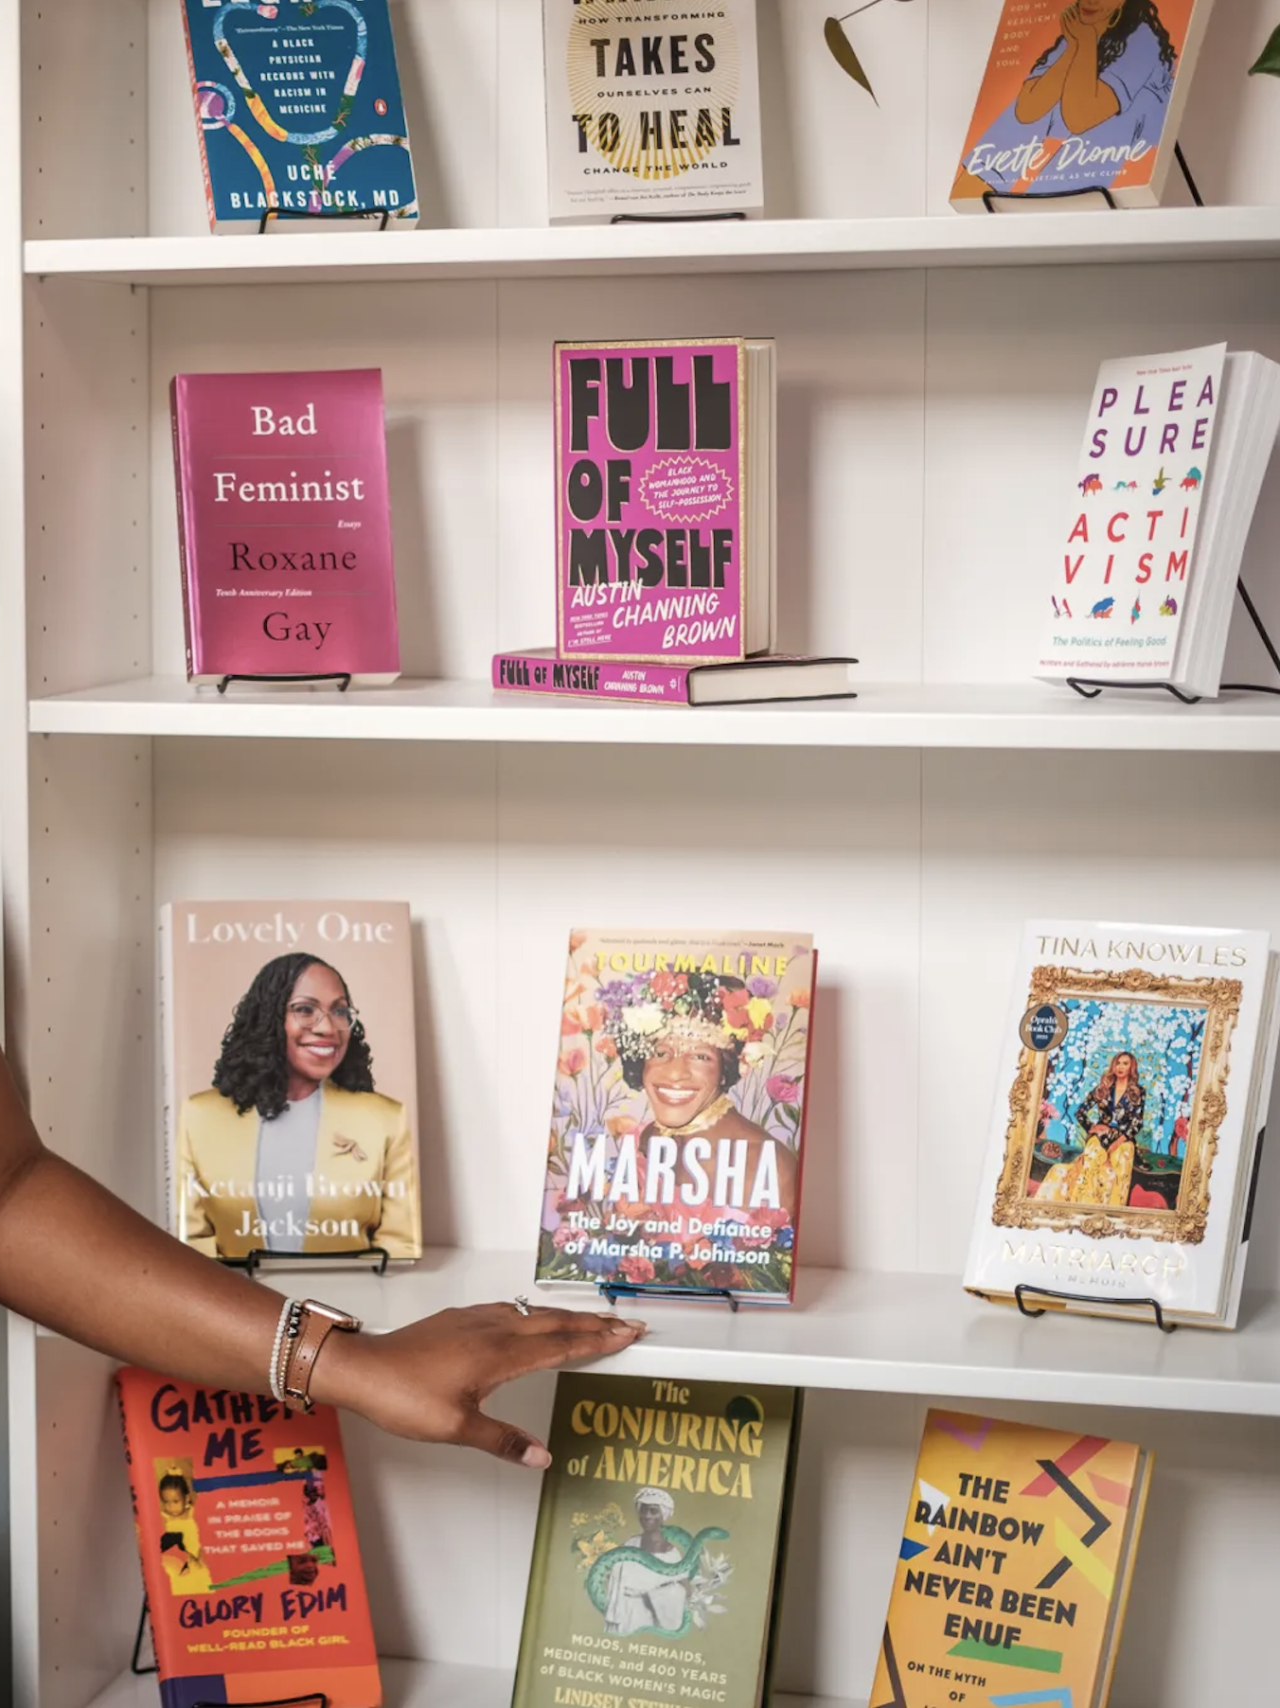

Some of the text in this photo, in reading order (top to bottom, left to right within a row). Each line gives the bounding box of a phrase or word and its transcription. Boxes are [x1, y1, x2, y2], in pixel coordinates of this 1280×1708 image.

[616, 11, 725, 22] TRANSFORMING
[272, 39, 314, 48] A BLACK
[590, 33, 716, 77] TAKES
[269, 55, 322, 64] PHYSICIAN
[260, 71, 335, 81] RECKONS WITH
[274, 88, 326, 97] RACISM IN
[597, 88, 678, 98] OURSELVES
[279, 104, 327, 114] MEDICINE
[572, 107, 740, 153] TO HEAL
[287, 160, 336, 181] UCHÉ
[583, 166, 639, 175] CHANGE
[679, 161, 728, 170] WORLD
[967, 135, 1152, 181] Evette Dionne
[1100, 169, 1128, 177] CLIMB
[230, 190, 399, 209] BLACKSTOCK, MD
[568, 355, 732, 453] FULL
[1097, 374, 1214, 418] PLEA
[251, 403, 318, 436] Bad
[1088, 418, 1209, 458] SURE
[213, 470, 365, 502] Feminist
[648, 474, 716, 489] WOMANHOOD AND
[668, 466, 693, 477] BLACK
[566, 458, 631, 523] OF
[653, 484, 718, 499] THE JOURNEY TO
[658, 494, 722, 510] SELF-POSSESSION
[337, 519, 362, 530] Essays
[1067, 507, 1189, 543] ACTI
[228, 542, 357, 571] Roxane
[568, 528, 733, 590] MYSELF
[1063, 550, 1189, 584] VISM
[215, 588, 312, 599] Tenth Anniversary Edition
[571, 578, 643, 609] AUSTIN
[612, 592, 720, 628] CHANNING
[262, 611, 333, 650] Gay
[662, 614, 737, 649] BROWN
[1053, 636, 1167, 648] The Politics of Feeling Good
[500, 659, 600, 691] FULL OF MYSELF
[603, 682, 665, 694] CHANNING BROWN
[622, 670, 647, 681] AUSTIN
[187, 912, 394, 948] Lovely One
[595, 952, 788, 976] TOURMALINE
[1036, 935, 1247, 966] TINA KNOWLES
[566, 1133, 781, 1209] MARSHA
[186, 1173, 406, 1203] Ketanji Brown
[234, 1210, 360, 1237] Jackson
[568, 1212, 771, 1238] The Joy and Defiance
[565, 1239, 770, 1264] of Marsha P. Johnson
[1002, 1240, 1182, 1279] MATRIARCH
[1068, 1275, 1127, 1288] MEMOIR
[651, 1379, 690, 1404] The
[151, 1383, 316, 1432] GATHE
[571, 1400, 764, 1458] CONJURING
[204, 1428, 265, 1469] ME
[567, 1446, 753, 1498] of AMERICA
[958, 1472, 1010, 1504] THE
[207, 1511, 291, 1524] IN PRAISE OF
[216, 1497, 279, 1509] A MEMOIR
[214, 1527, 289, 1538] THE BOOKS
[914, 1500, 1045, 1547] RAINBOW
[204, 1541, 304, 1554] THAT SAVED ME
[933, 1540, 1007, 1575] AIN'T
[179, 1583, 347, 1629] GLORY EDIM
[904, 1568, 1077, 1627] NEVER BEEN
[187, 1635, 350, 1653] WELL-READ BLACK GIRL
[222, 1625, 310, 1638] FOUNDER OF
[943, 1613, 1022, 1650] ENUF
[571, 1634, 706, 1666] MOJOS, MERMAIDS,
[543, 1647, 727, 1685] MEDICINE, and 400 YEARS
[907, 1661, 987, 1688] ON THE MYTH
[540, 1664, 726, 1702] of BLACK WOMEN'S MAGIC
[554, 1686, 623, 1708] LINDSEY
[948, 1691, 966, 1703] OF
